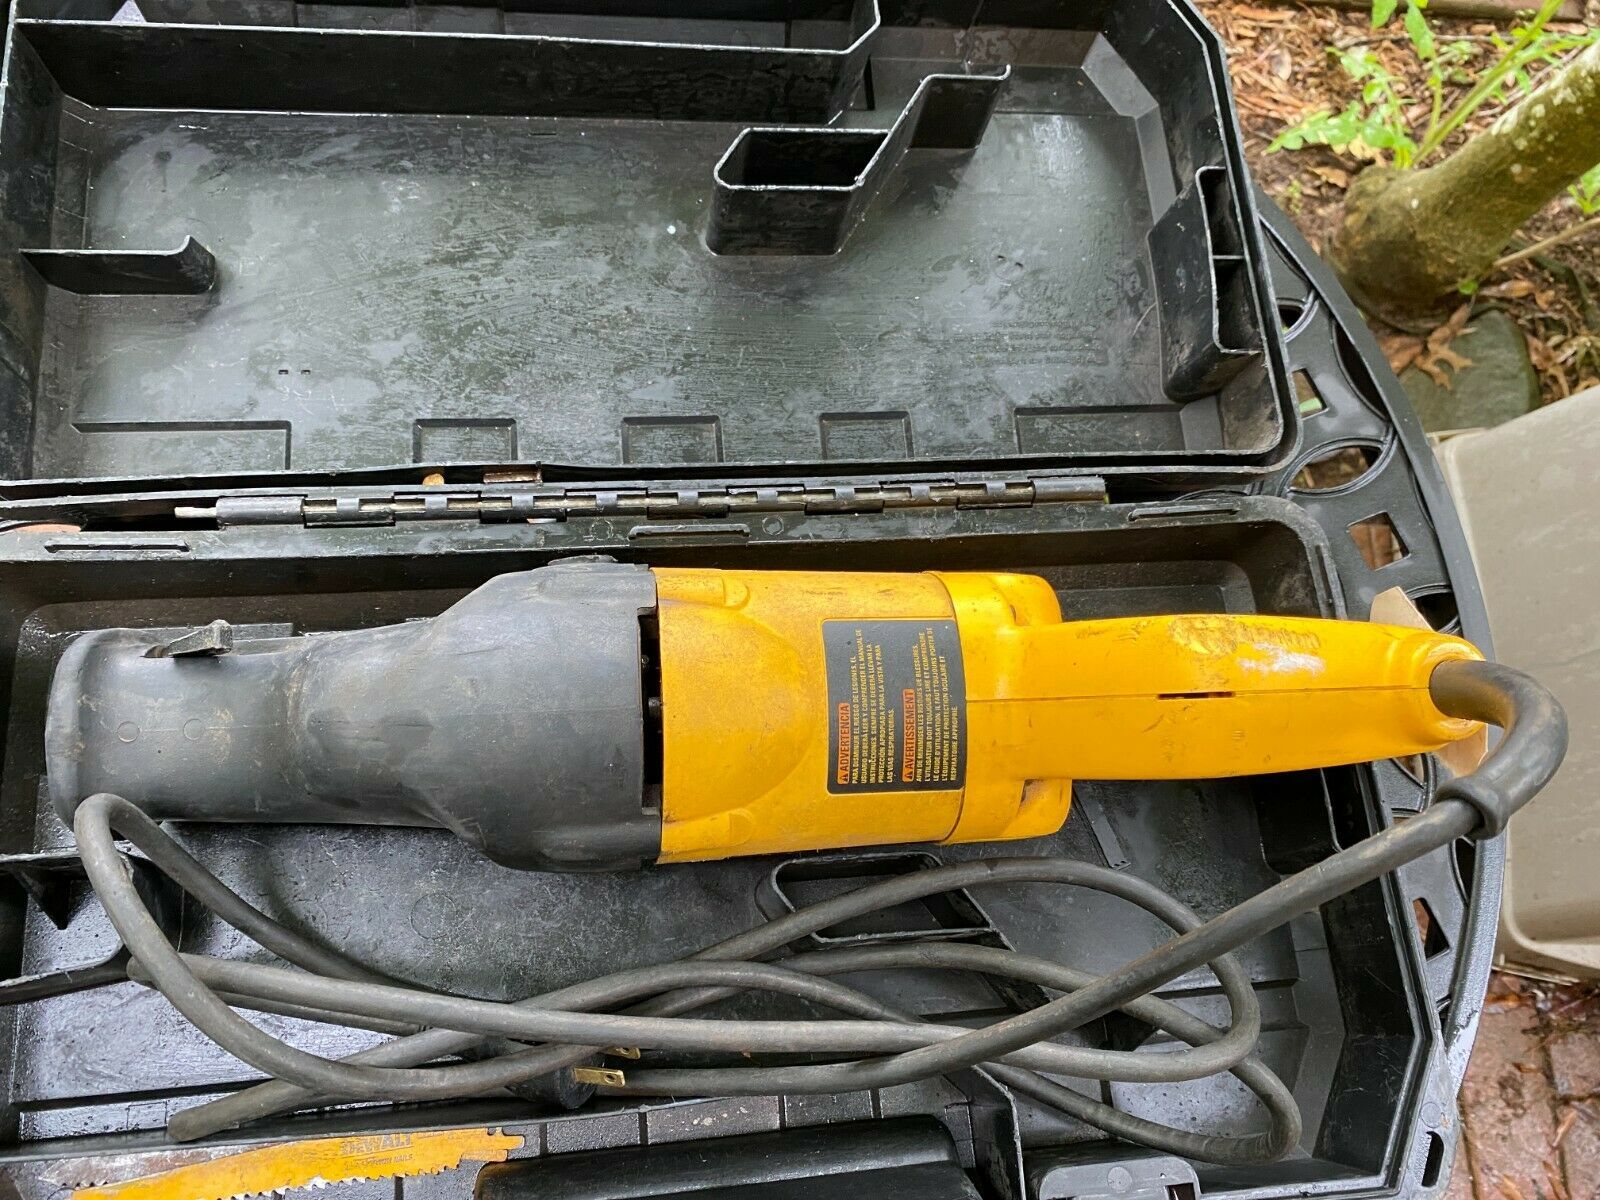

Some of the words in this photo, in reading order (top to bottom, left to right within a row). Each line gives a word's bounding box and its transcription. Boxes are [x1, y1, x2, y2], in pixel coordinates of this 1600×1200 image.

[919, 632, 929, 670] COMPRENDRE
[928, 636, 936, 656] PORTER
[931, 658, 939, 688] TOUJOURS
[840, 705, 849, 771] ADVERTENCIA
[905, 692, 914, 769] AVERTISSEMENT
